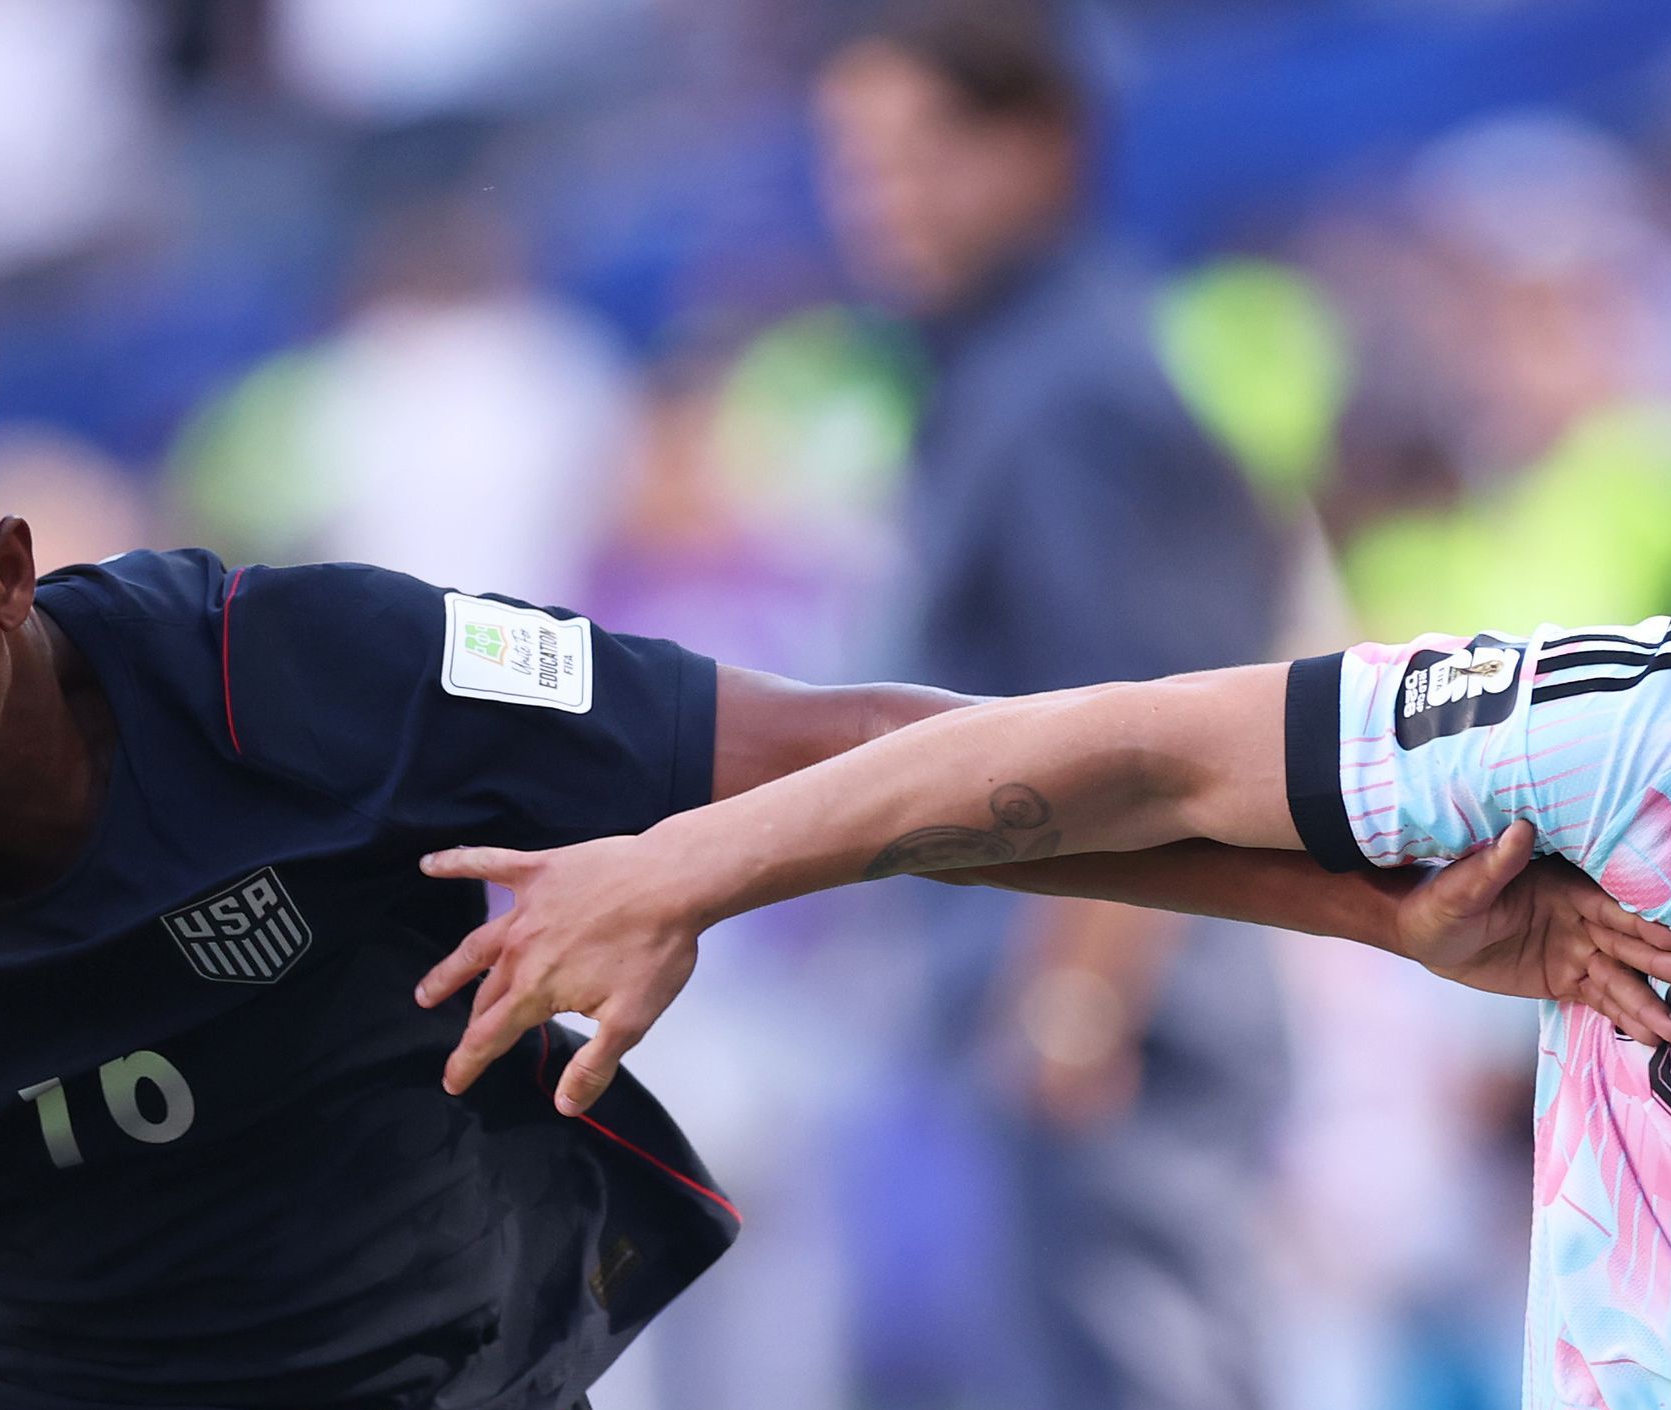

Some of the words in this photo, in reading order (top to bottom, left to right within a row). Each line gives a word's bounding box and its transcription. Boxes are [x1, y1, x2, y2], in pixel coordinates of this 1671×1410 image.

[538, 626, 559, 690] EDUCATION
[563, 655, 574, 676] FIFA
[1404, 670, 1419, 718] 026
[173, 876, 280, 938] USA
